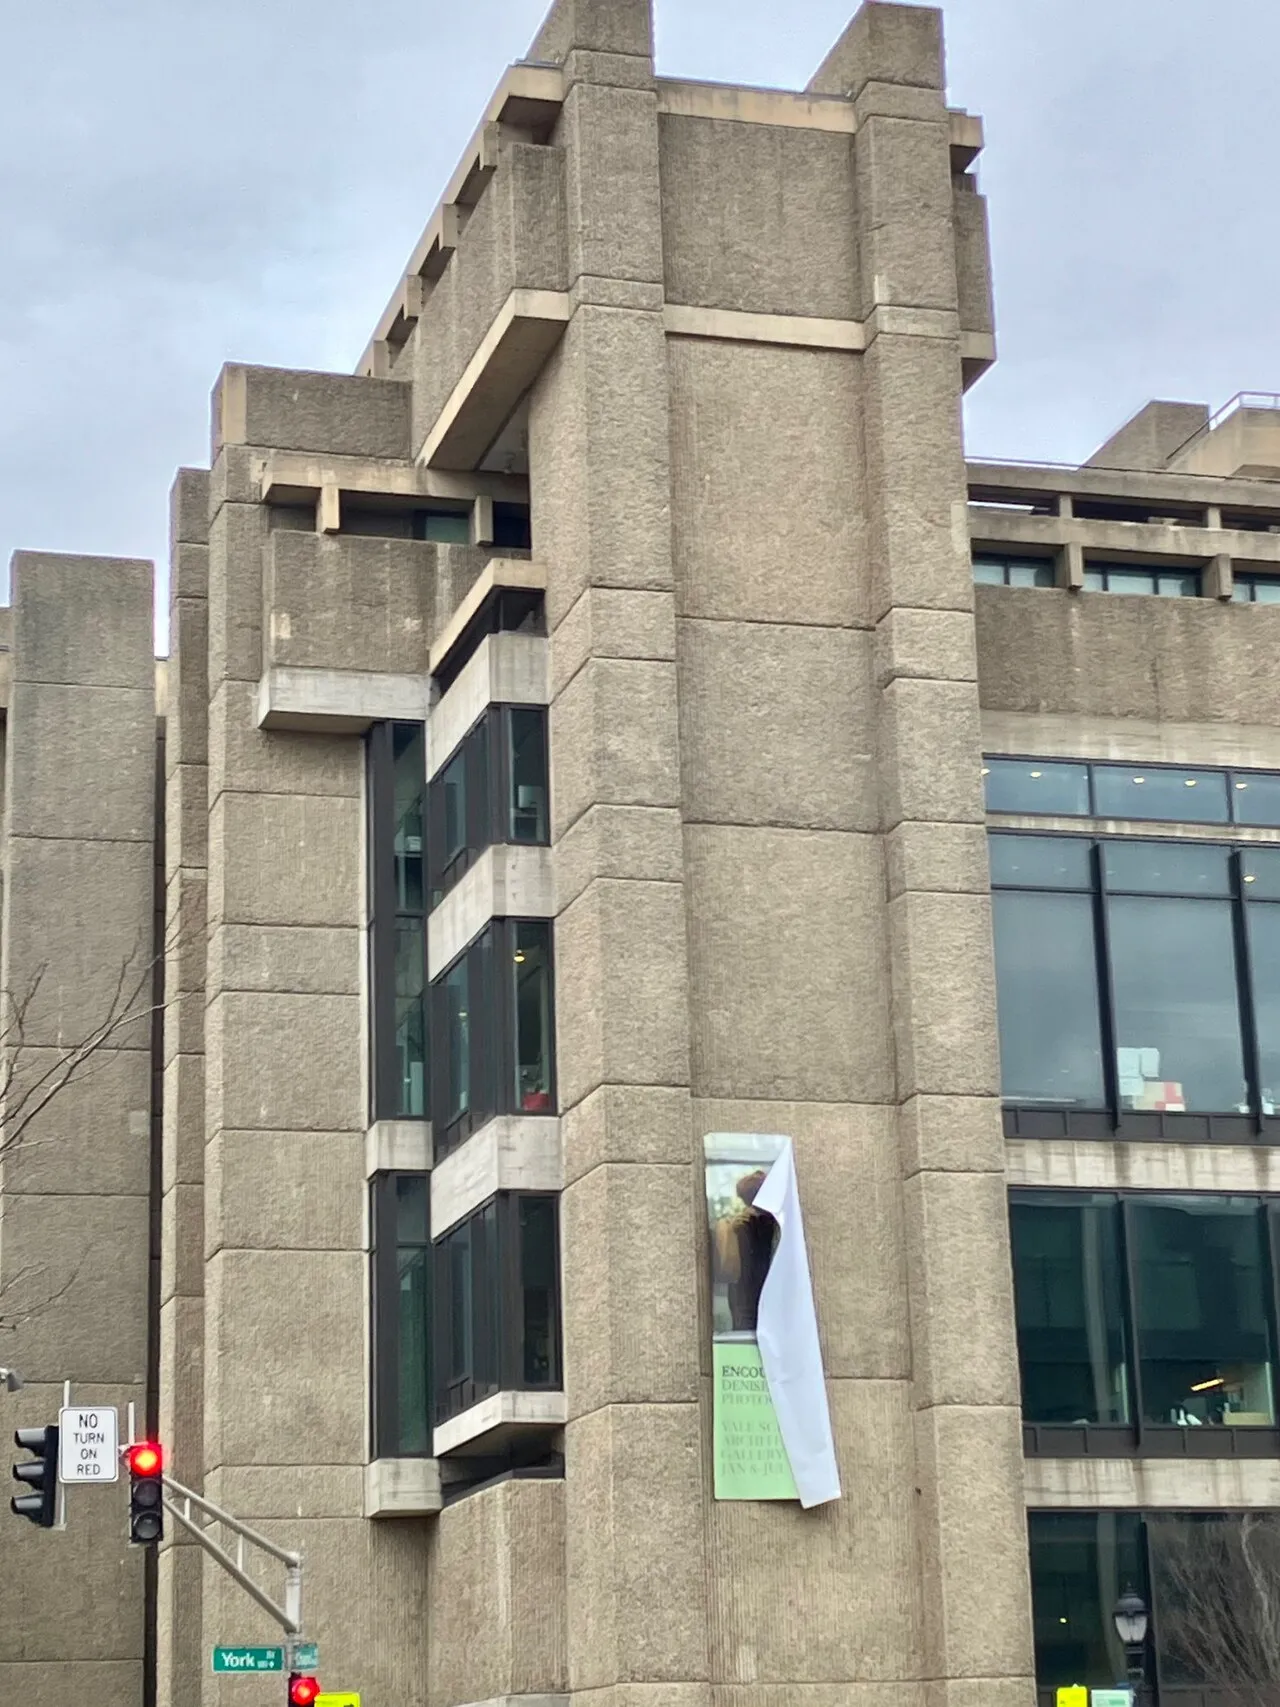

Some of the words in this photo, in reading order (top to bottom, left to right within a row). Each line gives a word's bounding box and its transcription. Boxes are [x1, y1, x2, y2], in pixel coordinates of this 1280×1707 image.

[79, 1413, 98, 1428] NO
[74, 1432, 104, 1444] TURN
[80, 1448, 97, 1460] ON
[77, 1464, 101, 1475] RED
[221, 1652, 255, 1667] York
